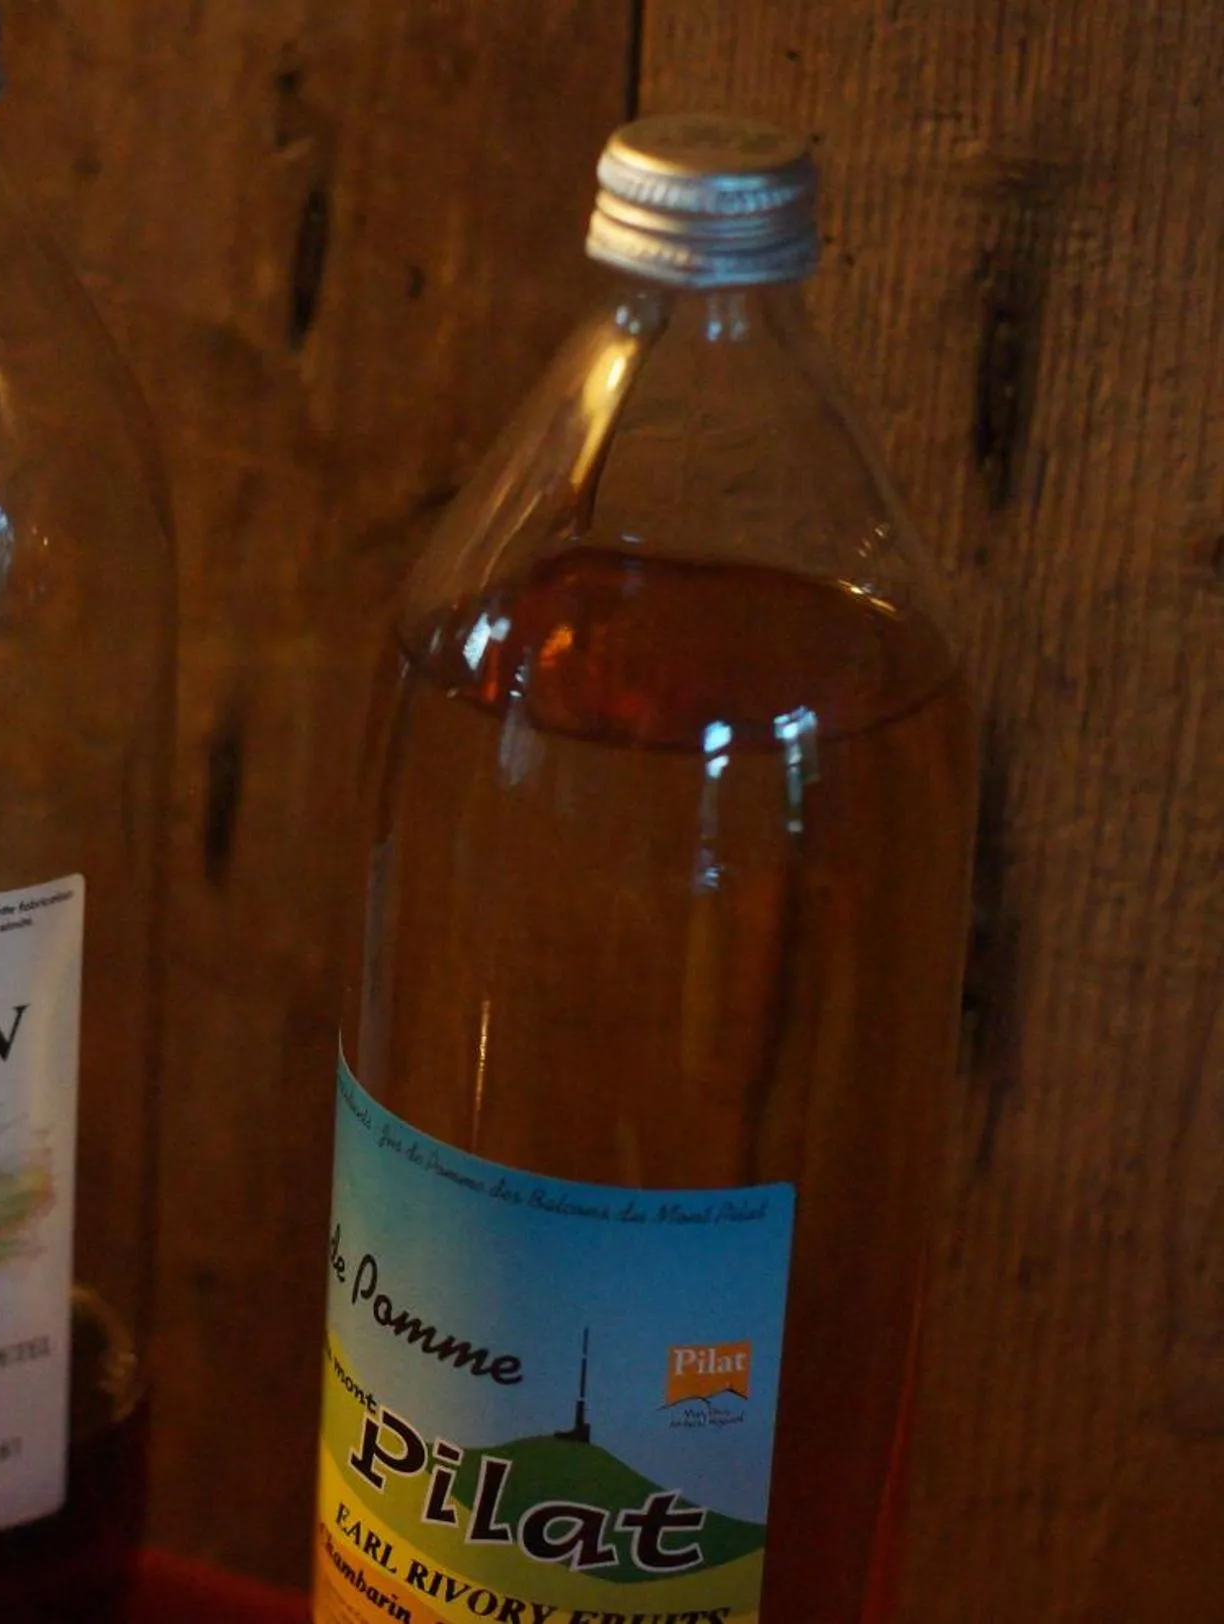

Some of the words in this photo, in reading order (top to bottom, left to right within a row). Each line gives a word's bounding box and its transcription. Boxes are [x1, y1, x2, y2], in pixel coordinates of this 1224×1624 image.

[351, 1254, 523, 1386] Pomme
[673, 1347, 748, 1378] Pilat
[349, 1411, 706, 1571] Pilat
[335, 1502, 398, 1575] EARL
[404, 1558, 558, 1624] RIVORY
